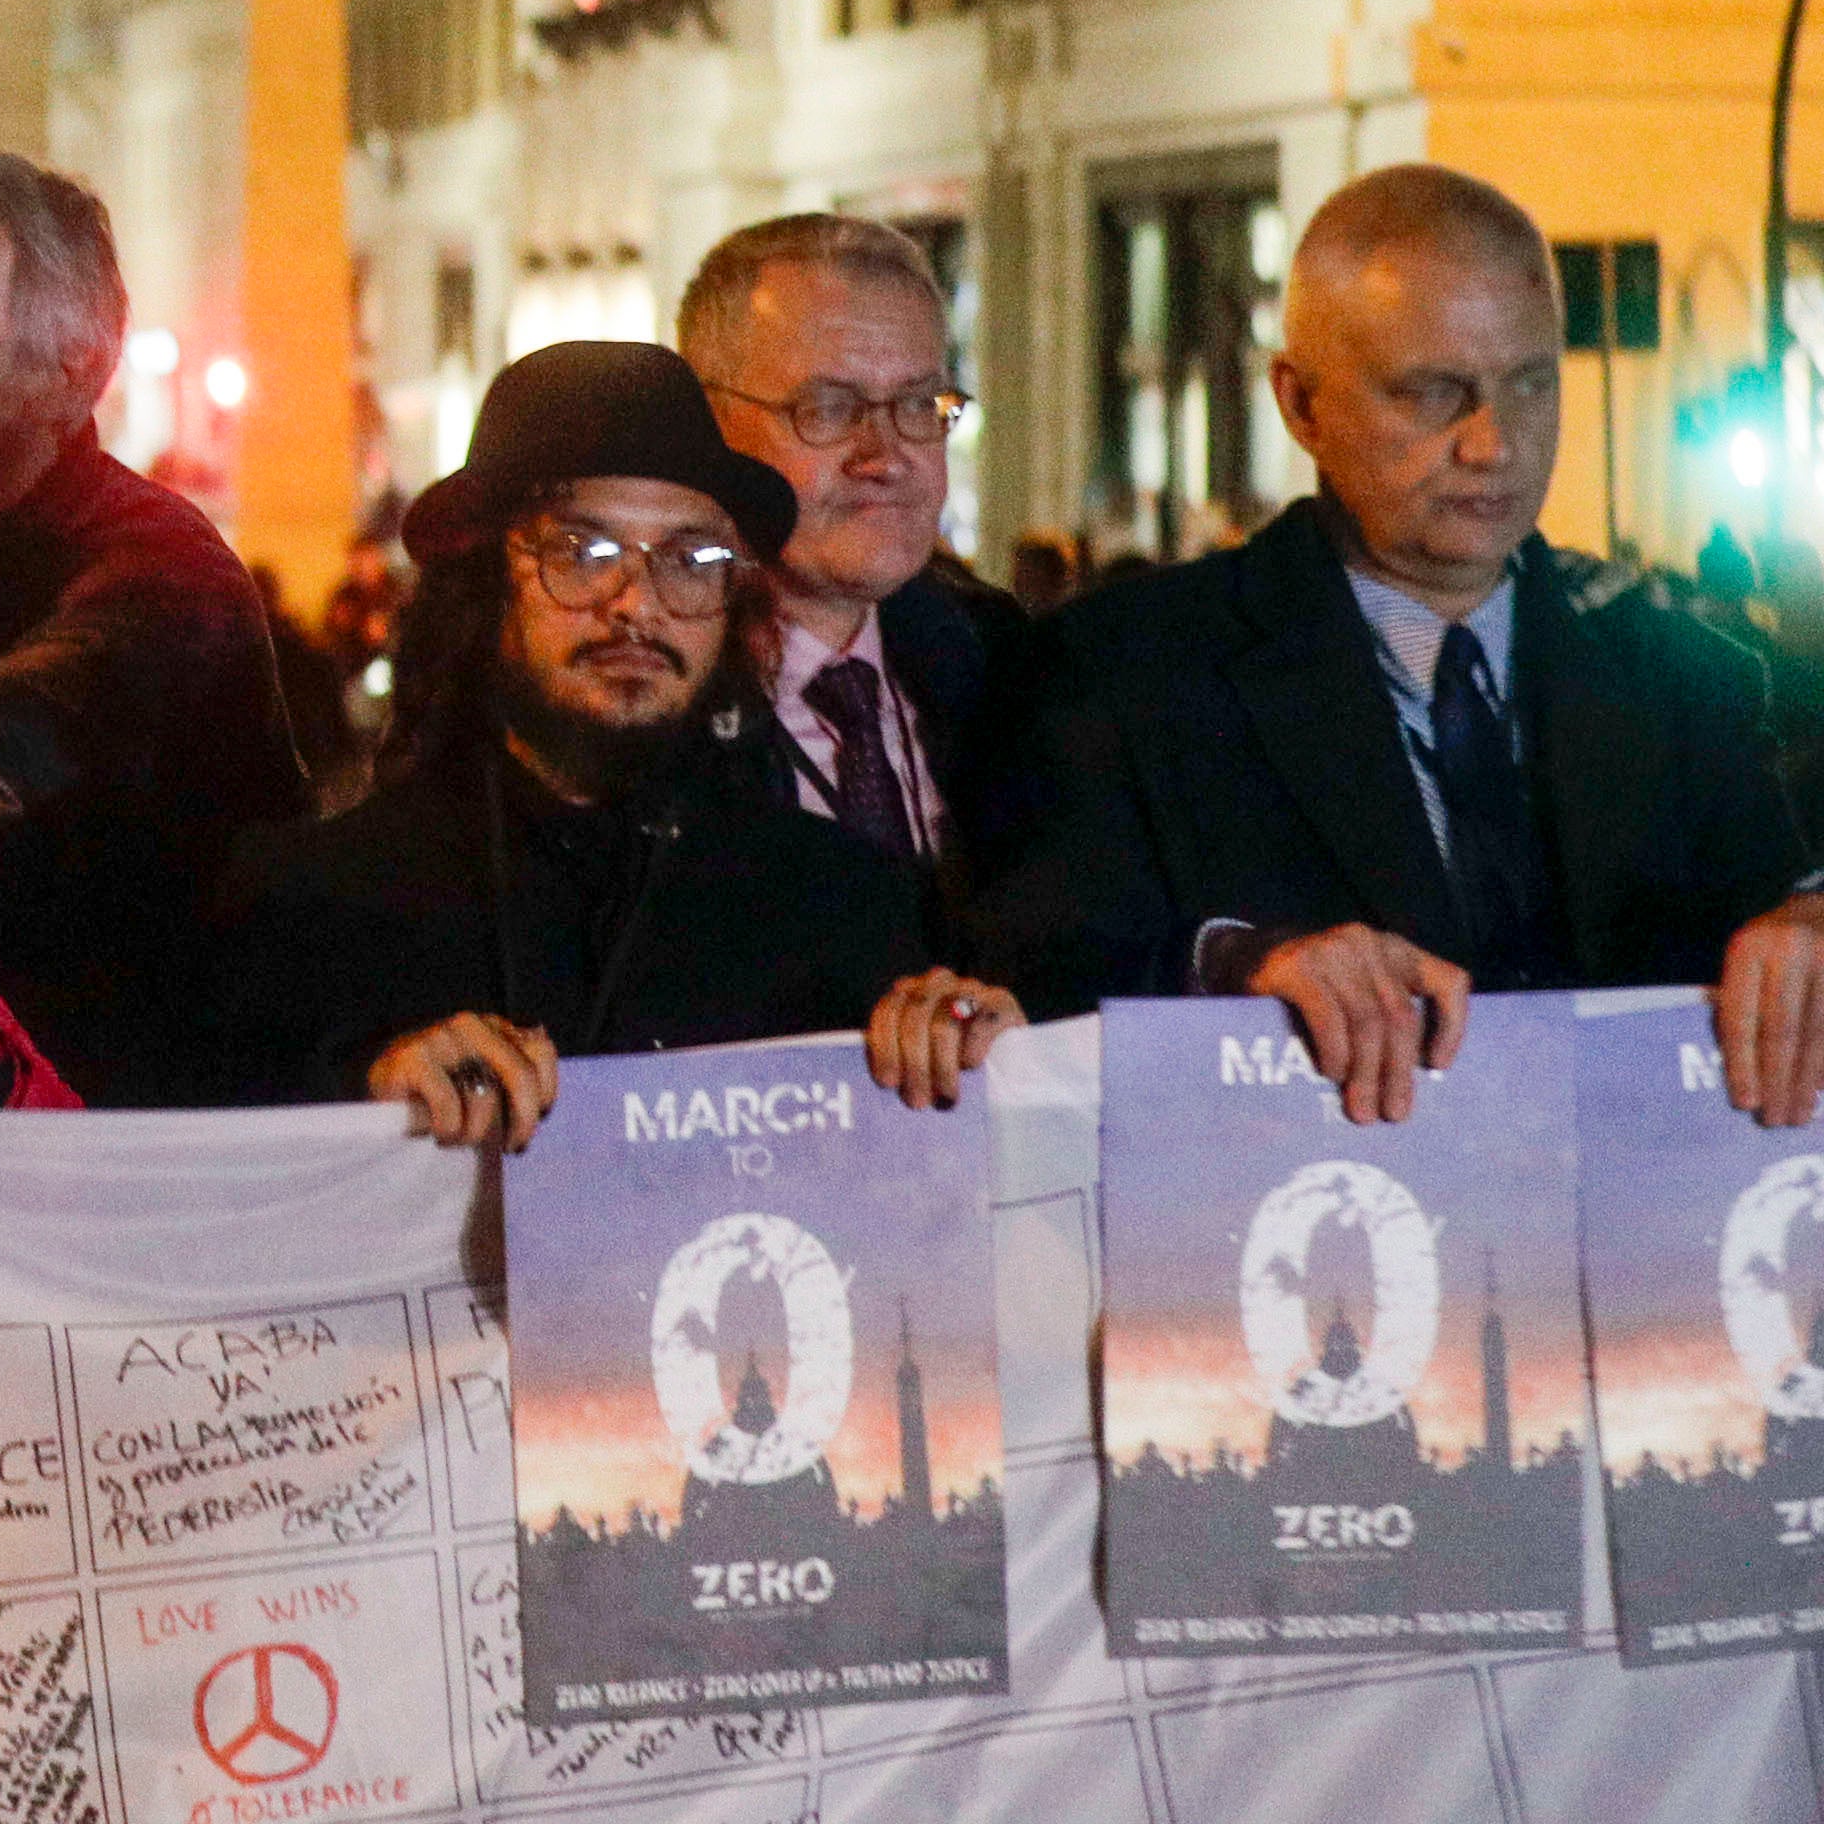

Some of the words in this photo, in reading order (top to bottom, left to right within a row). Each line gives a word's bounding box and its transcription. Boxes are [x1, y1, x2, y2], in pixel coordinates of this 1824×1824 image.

[622, 1080, 854, 1144] MARCH
[726, 1141, 773, 1176] TO
[116, 1317, 338, 1384] ACABA
[1272, 1504, 1414, 1550] ZERO
[135, 1598, 220, 1647] LOVE
[257, 1579, 360, 1624] WINS
[691, 1556, 835, 1611] ZERO
